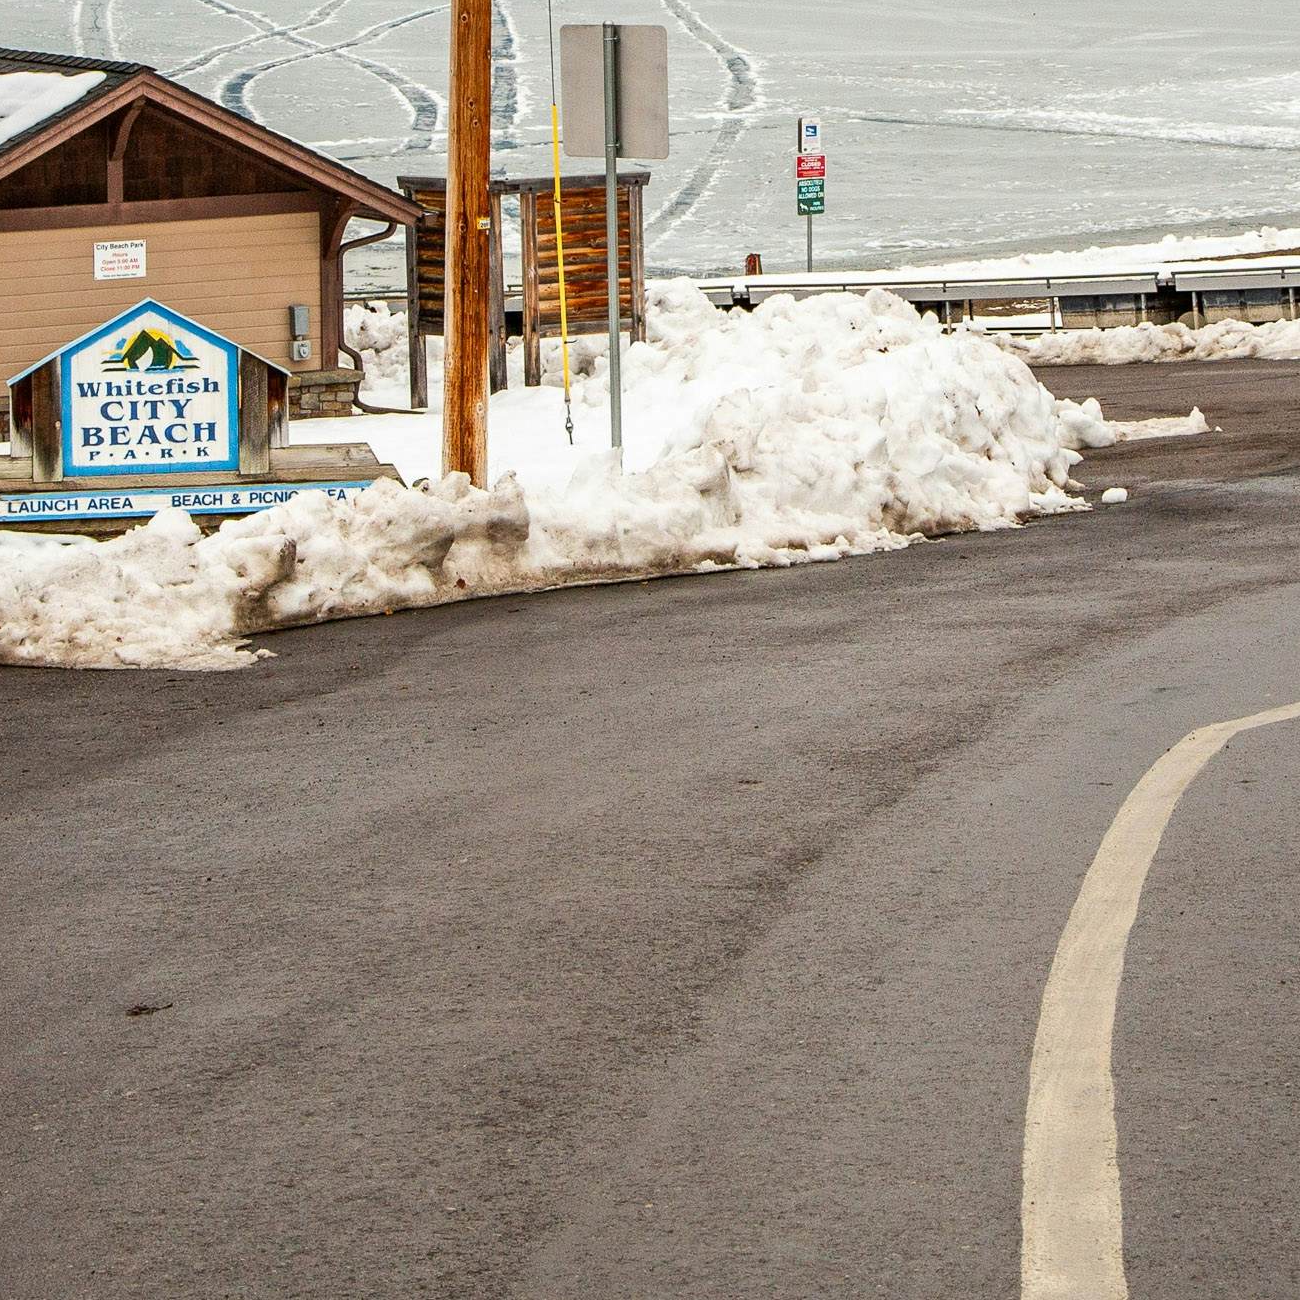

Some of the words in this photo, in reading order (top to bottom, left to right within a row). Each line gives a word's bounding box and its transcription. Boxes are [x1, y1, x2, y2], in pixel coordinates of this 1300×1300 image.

[77, 377, 220, 398] Whitefish
[100, 398, 193, 422] CITY
[81, 421, 218, 448] BEACH
[8, 499, 79, 514] LAUNCH
[87, 497, 134, 511] AREA
[172, 493, 223, 508] BEACH
[231, 493, 241, 505] &
